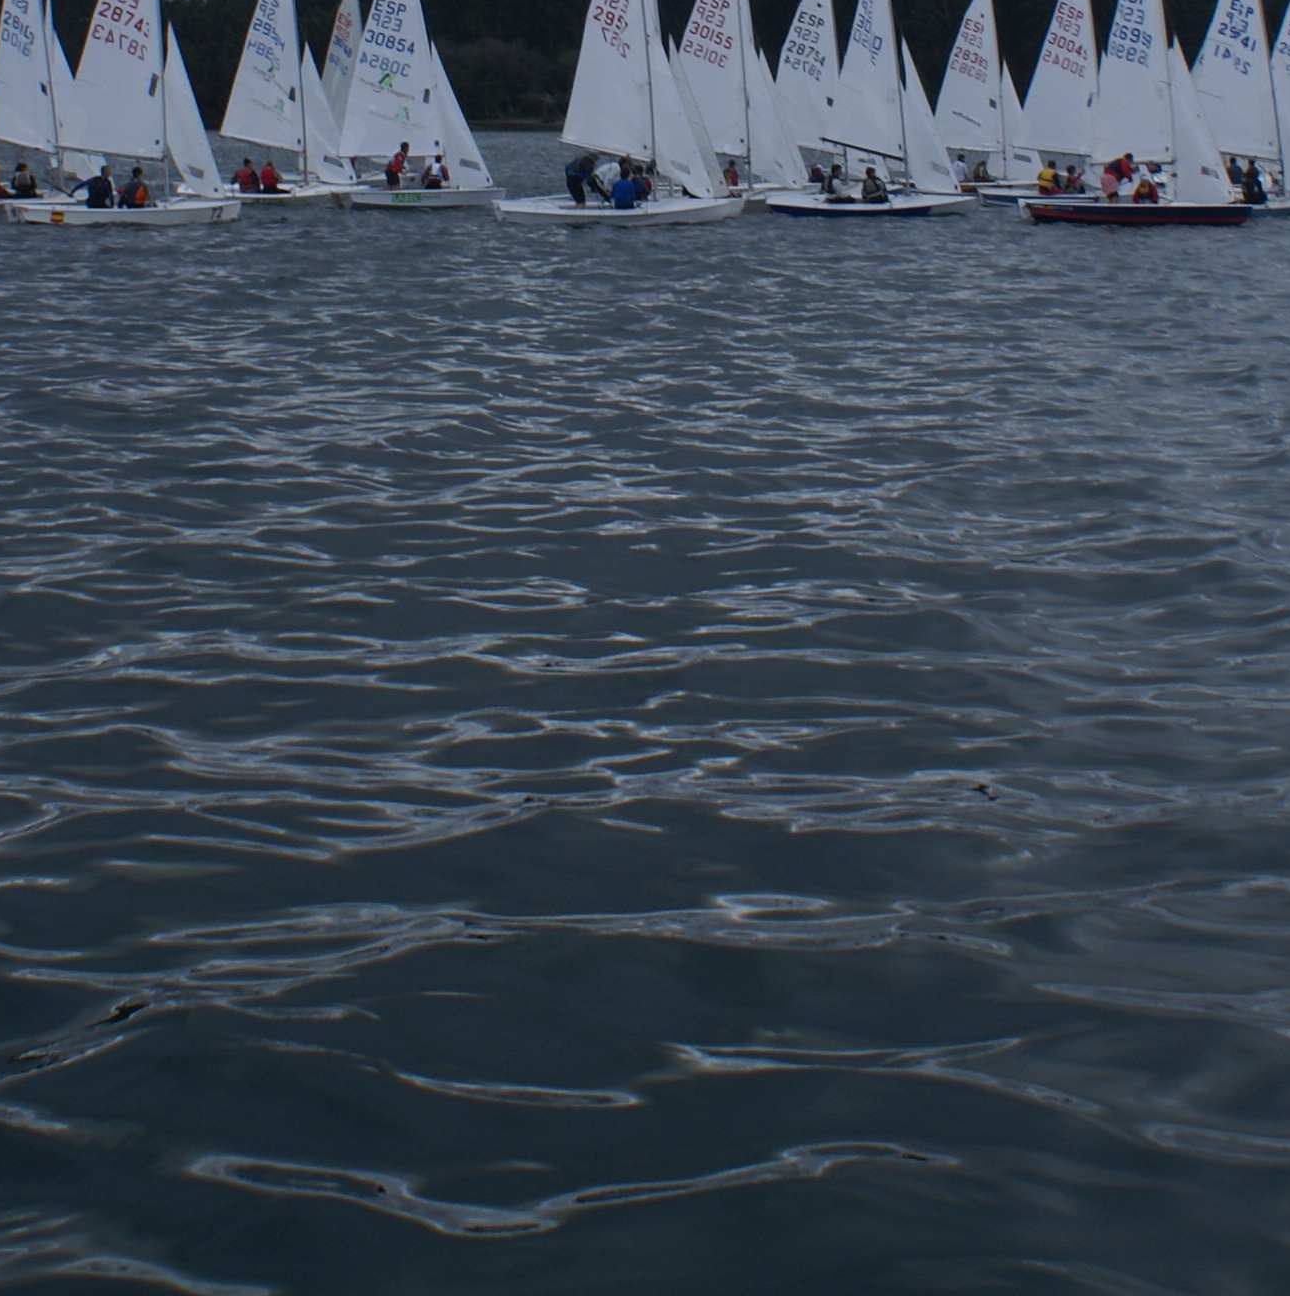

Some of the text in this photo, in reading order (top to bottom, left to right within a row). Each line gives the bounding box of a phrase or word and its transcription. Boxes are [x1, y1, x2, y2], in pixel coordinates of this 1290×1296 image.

[797, 10, 825, 28] ESP
[1057, 1, 1084, 21] ESP
[364, 29, 415, 56] 30854
[689, 20, 733, 50] 30155
[786, 39, 827, 67] 28754
